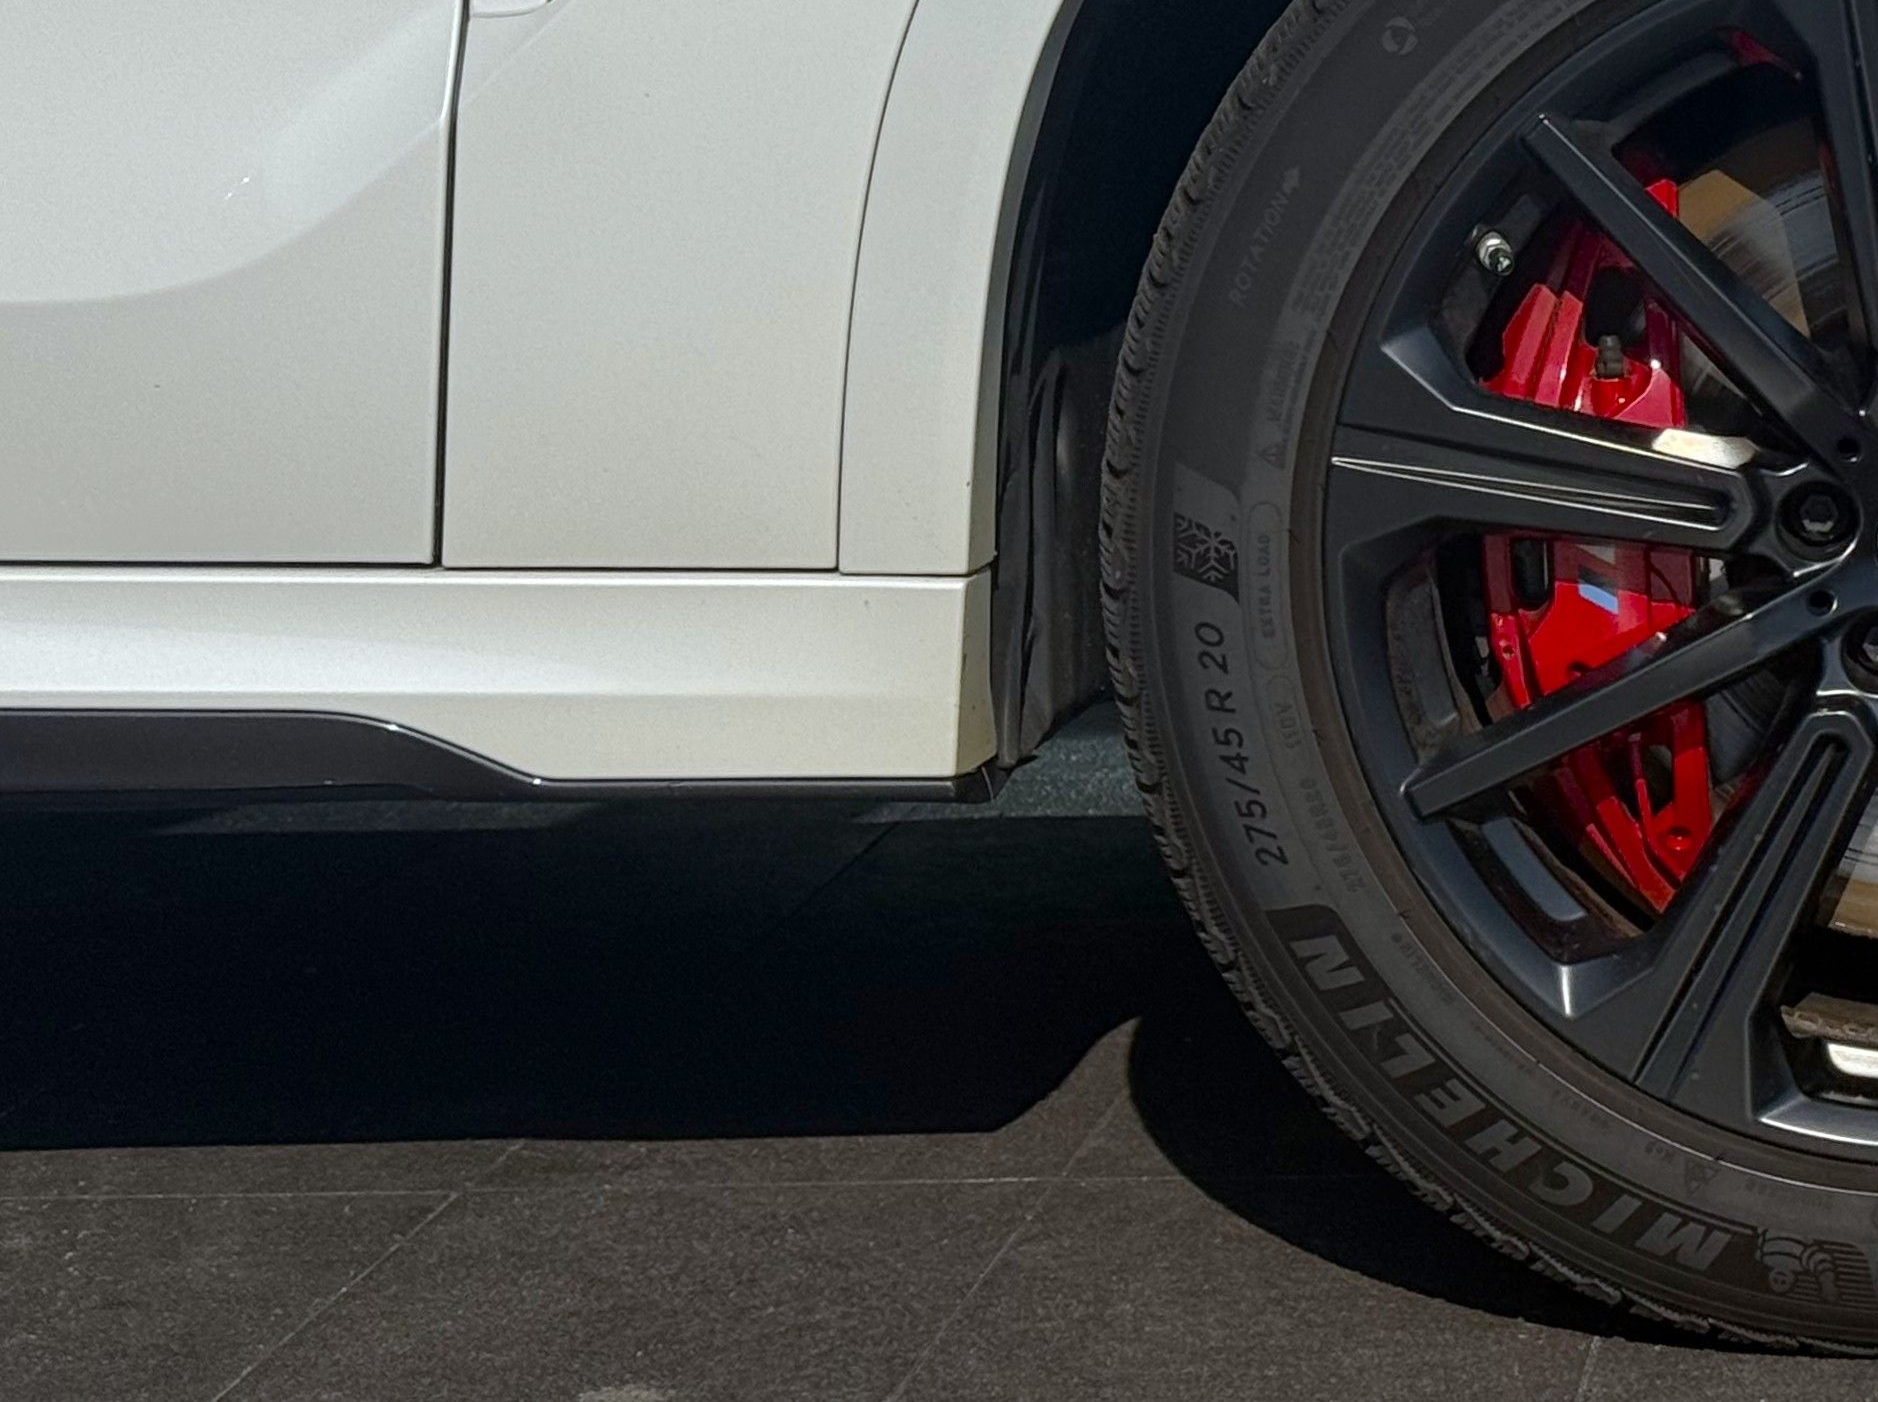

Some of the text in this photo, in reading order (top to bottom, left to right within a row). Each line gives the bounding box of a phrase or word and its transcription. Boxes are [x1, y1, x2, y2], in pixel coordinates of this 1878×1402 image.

[1227, 190, 1291, 307] ROTATION
[1257, 534, 1276, 638] EXTRA LOAD
[1195, 620, 1289, 867] 275/45 R 20
[1290, 933, 1732, 1273] MICHELIN
